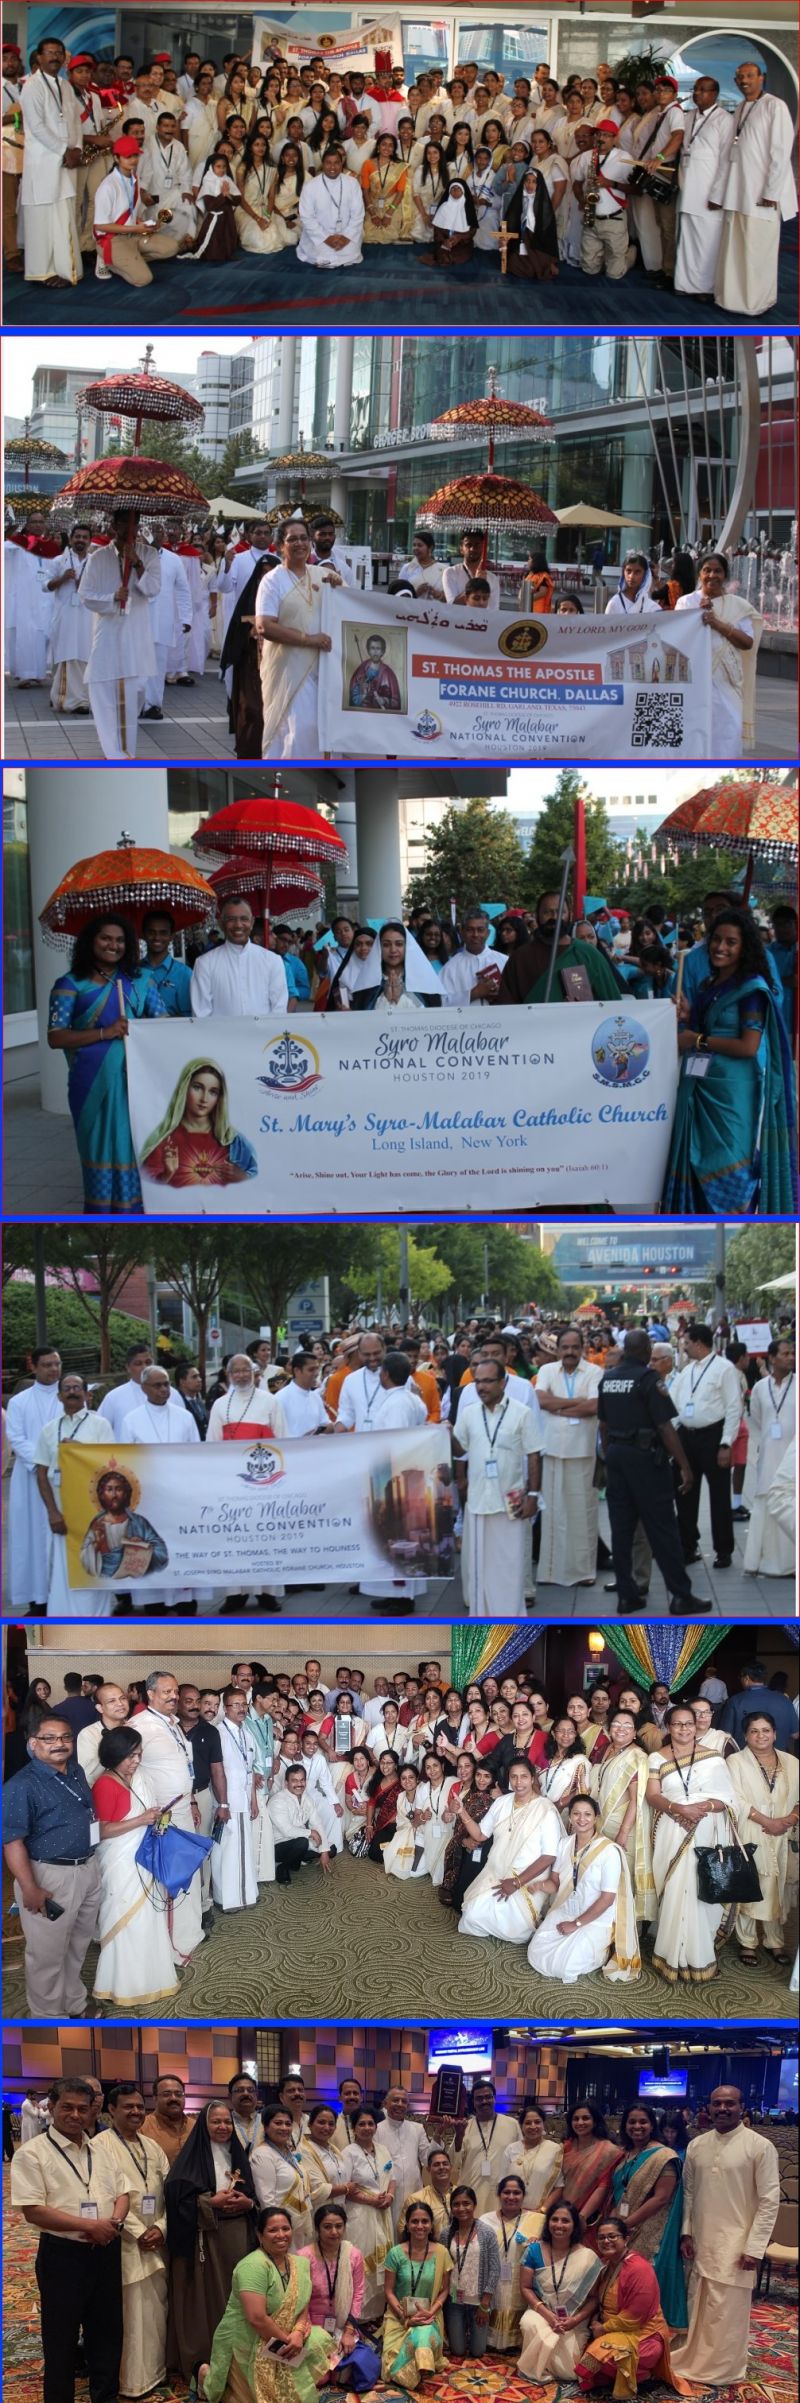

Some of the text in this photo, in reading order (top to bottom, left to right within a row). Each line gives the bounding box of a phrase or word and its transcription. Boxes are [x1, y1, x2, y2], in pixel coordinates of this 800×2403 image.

[422, 662, 595, 680] ST. THOMAS THE APOSTLE
[440, 683, 496, 698] FORANE
[565, 688, 618, 700] DALLAS
[472, 715, 559, 735] Syro Malabar
[450, 732, 506, 742] NATIONAL
[512, 734, 586, 743] CONVENTION
[375, 1030, 509, 1060] Syro Malabar
[339, 1053, 555, 1070] NATIONAL CONVENTION
[393, 1071, 491, 1082] HOUSTON 2019
[259, 1103, 668, 1137] St. Mary's Syro-Malabar Catholic Church
[372, 1135, 528, 1153] Long Island, New York
[438, 1170, 457, 1178] Glory
[509, 1166, 534, 1175] shining
[587, 1246, 694, 1263] AVENIDA HOUSTON
[602, 1379, 634, 1393] SHERIFF
[218, 1502, 251, 1525] Syro
[257, 1500, 326, 1519] Malabar
[179, 1517, 352, 1535] NATIONAL CONVENTION
[226, 1532, 304, 1544] HOUSTON 2019
[323, 1544, 360, 1552] HOLINESS
